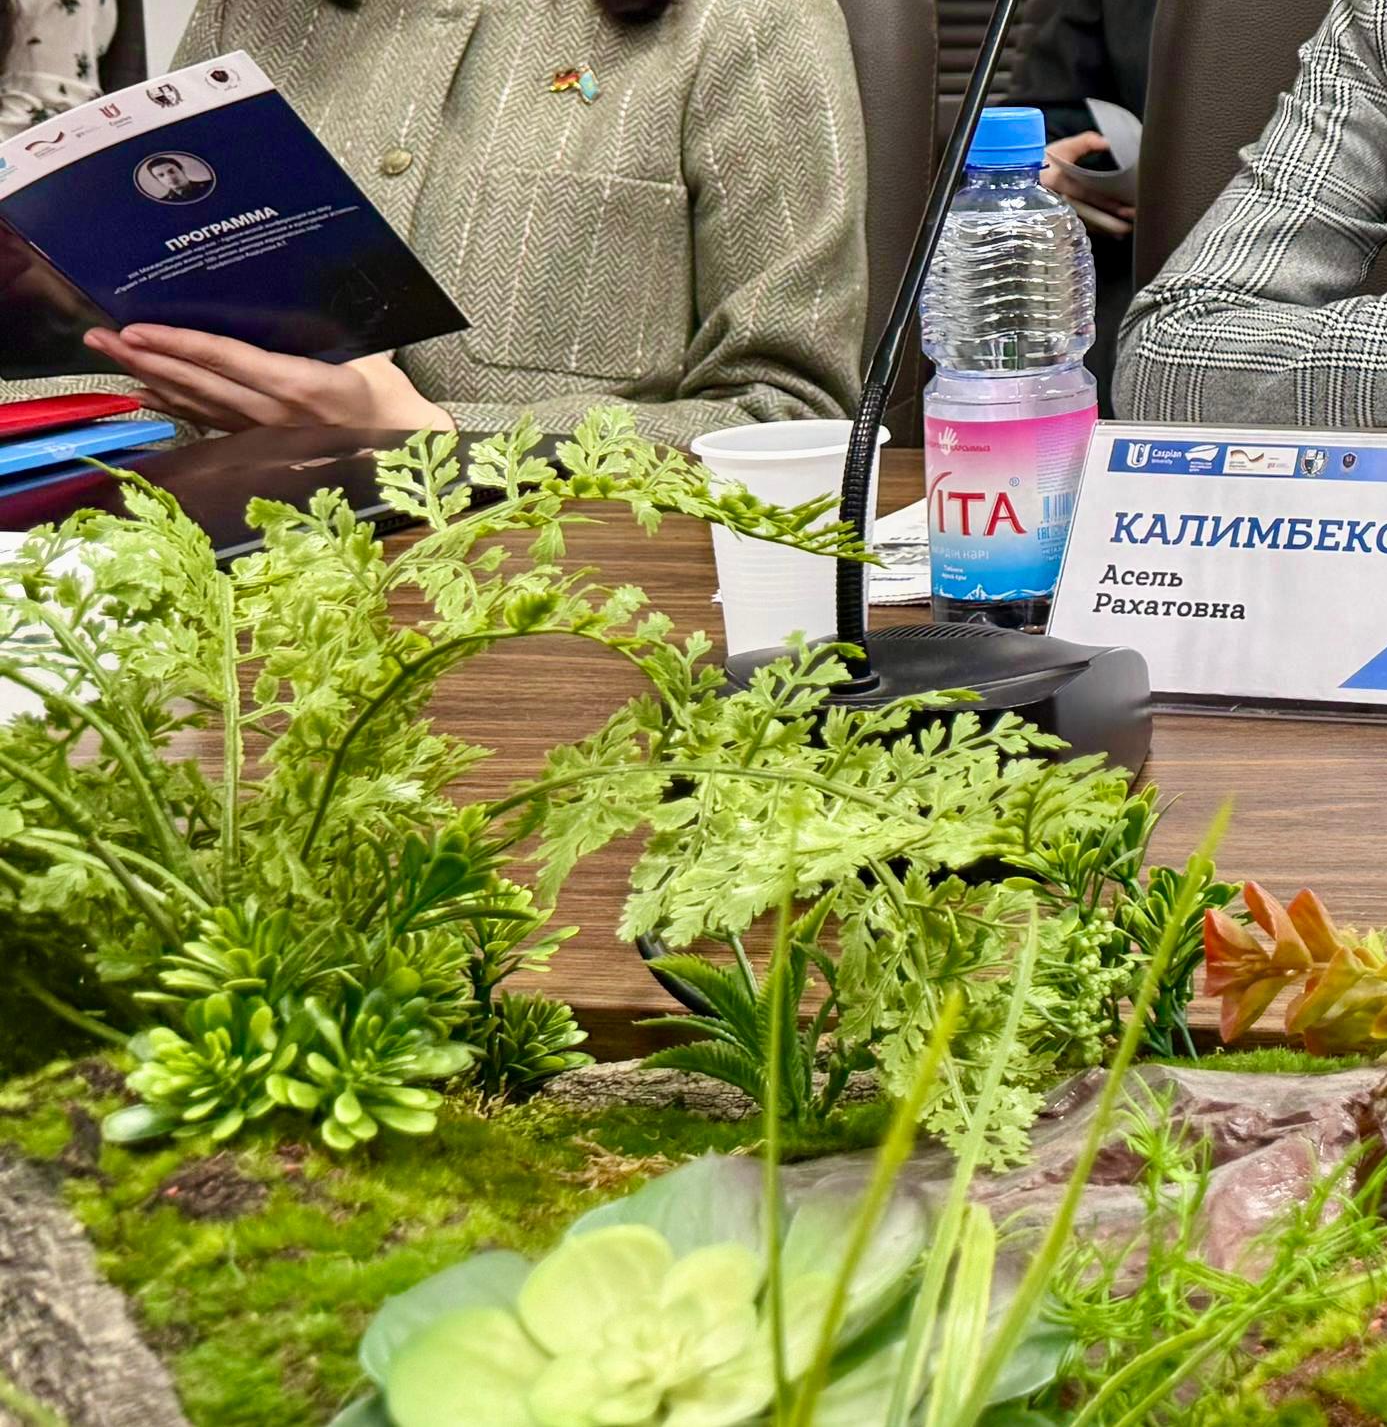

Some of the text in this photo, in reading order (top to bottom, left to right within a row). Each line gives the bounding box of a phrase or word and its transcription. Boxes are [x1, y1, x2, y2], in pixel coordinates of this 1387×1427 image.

[165, 205, 280, 252] ПРОГРАММА
[1152, 449, 1182, 458] Caspian
[1099, 564, 1184, 588] Асель
[1092, 593, 1246, 620] Рахатовна
